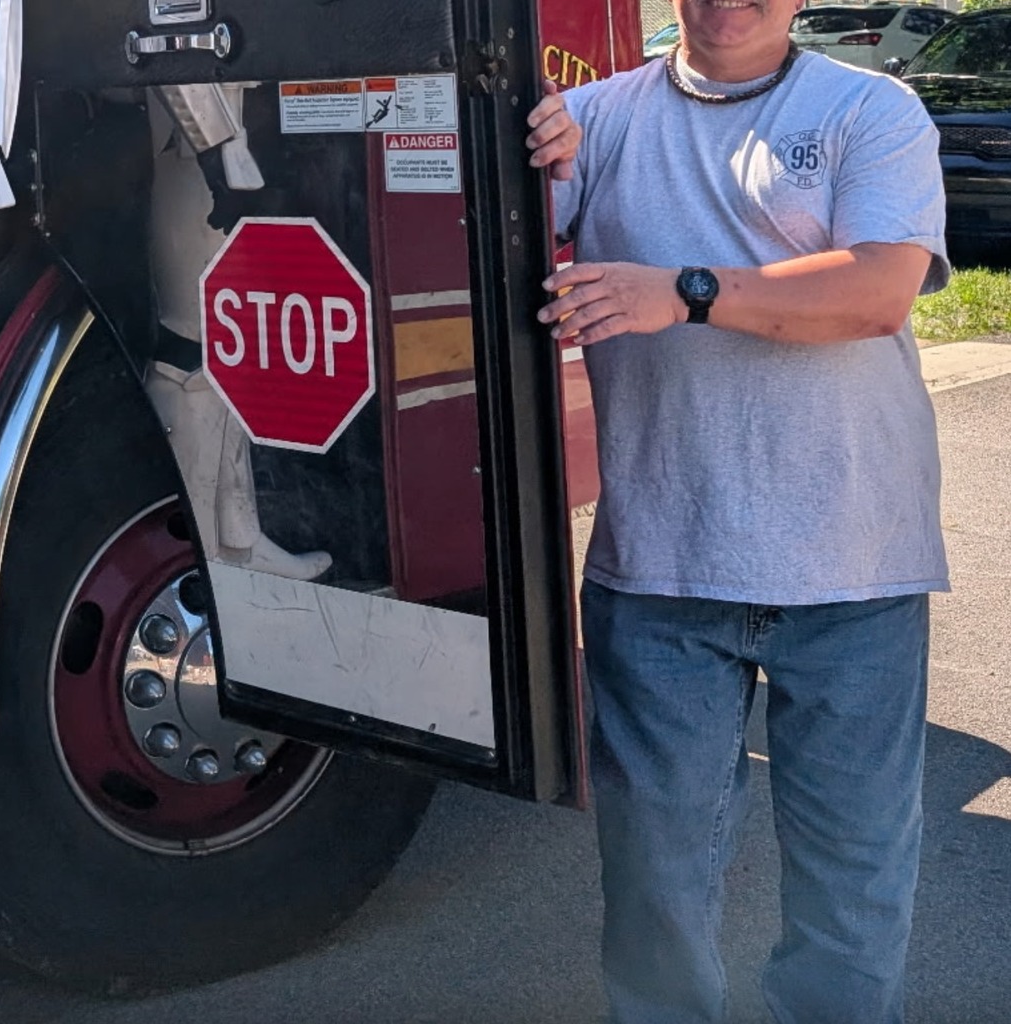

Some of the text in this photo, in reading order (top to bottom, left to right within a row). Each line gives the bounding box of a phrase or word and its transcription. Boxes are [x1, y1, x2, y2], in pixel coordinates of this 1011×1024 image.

[307, 83, 348, 94] WARNING
[400, 135, 454, 148] DANGER
[791, 144, 819, 170] 95
[213, 288, 358, 377] STOP
